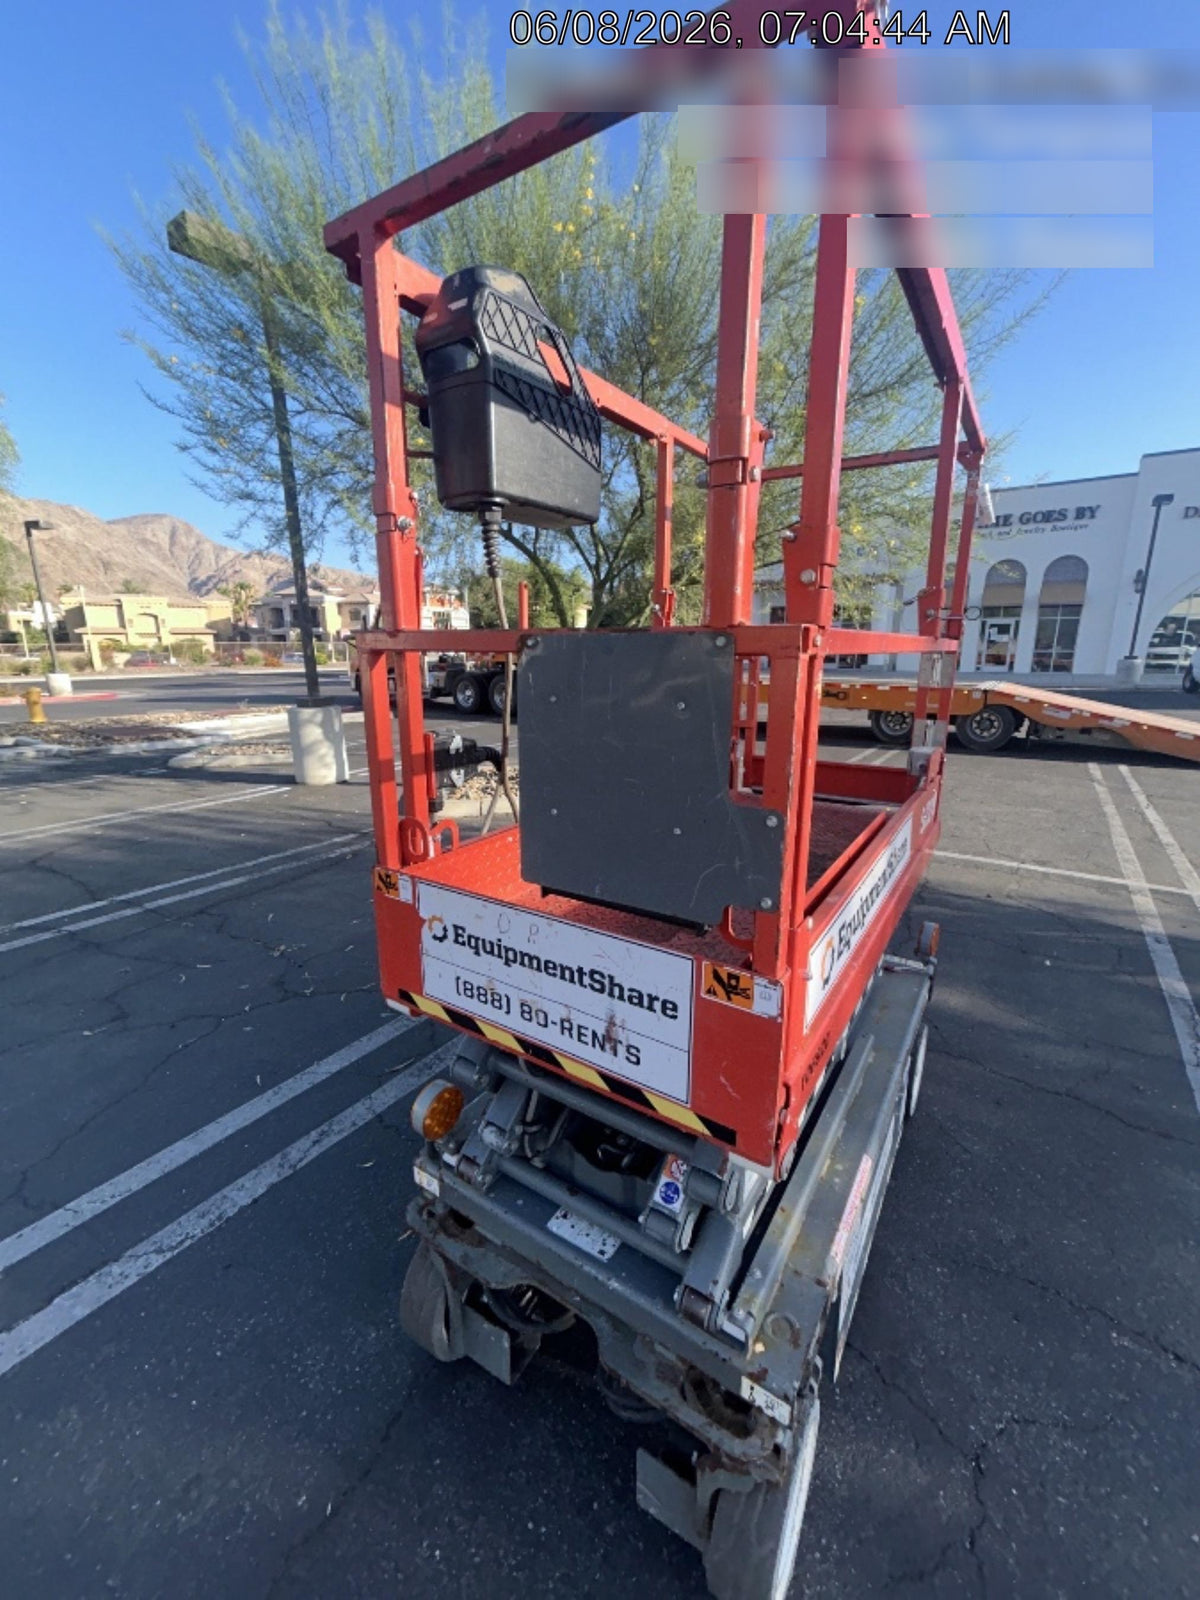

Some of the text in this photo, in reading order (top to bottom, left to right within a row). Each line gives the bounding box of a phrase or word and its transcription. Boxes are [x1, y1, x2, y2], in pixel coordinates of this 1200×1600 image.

[1019, 507, 1068, 526] GOES
[1074, 504, 1101, 521] BY
[452, 923, 679, 1021] EquipmentShare
[455, 975, 642, 1067] (888) 80-RENTS
